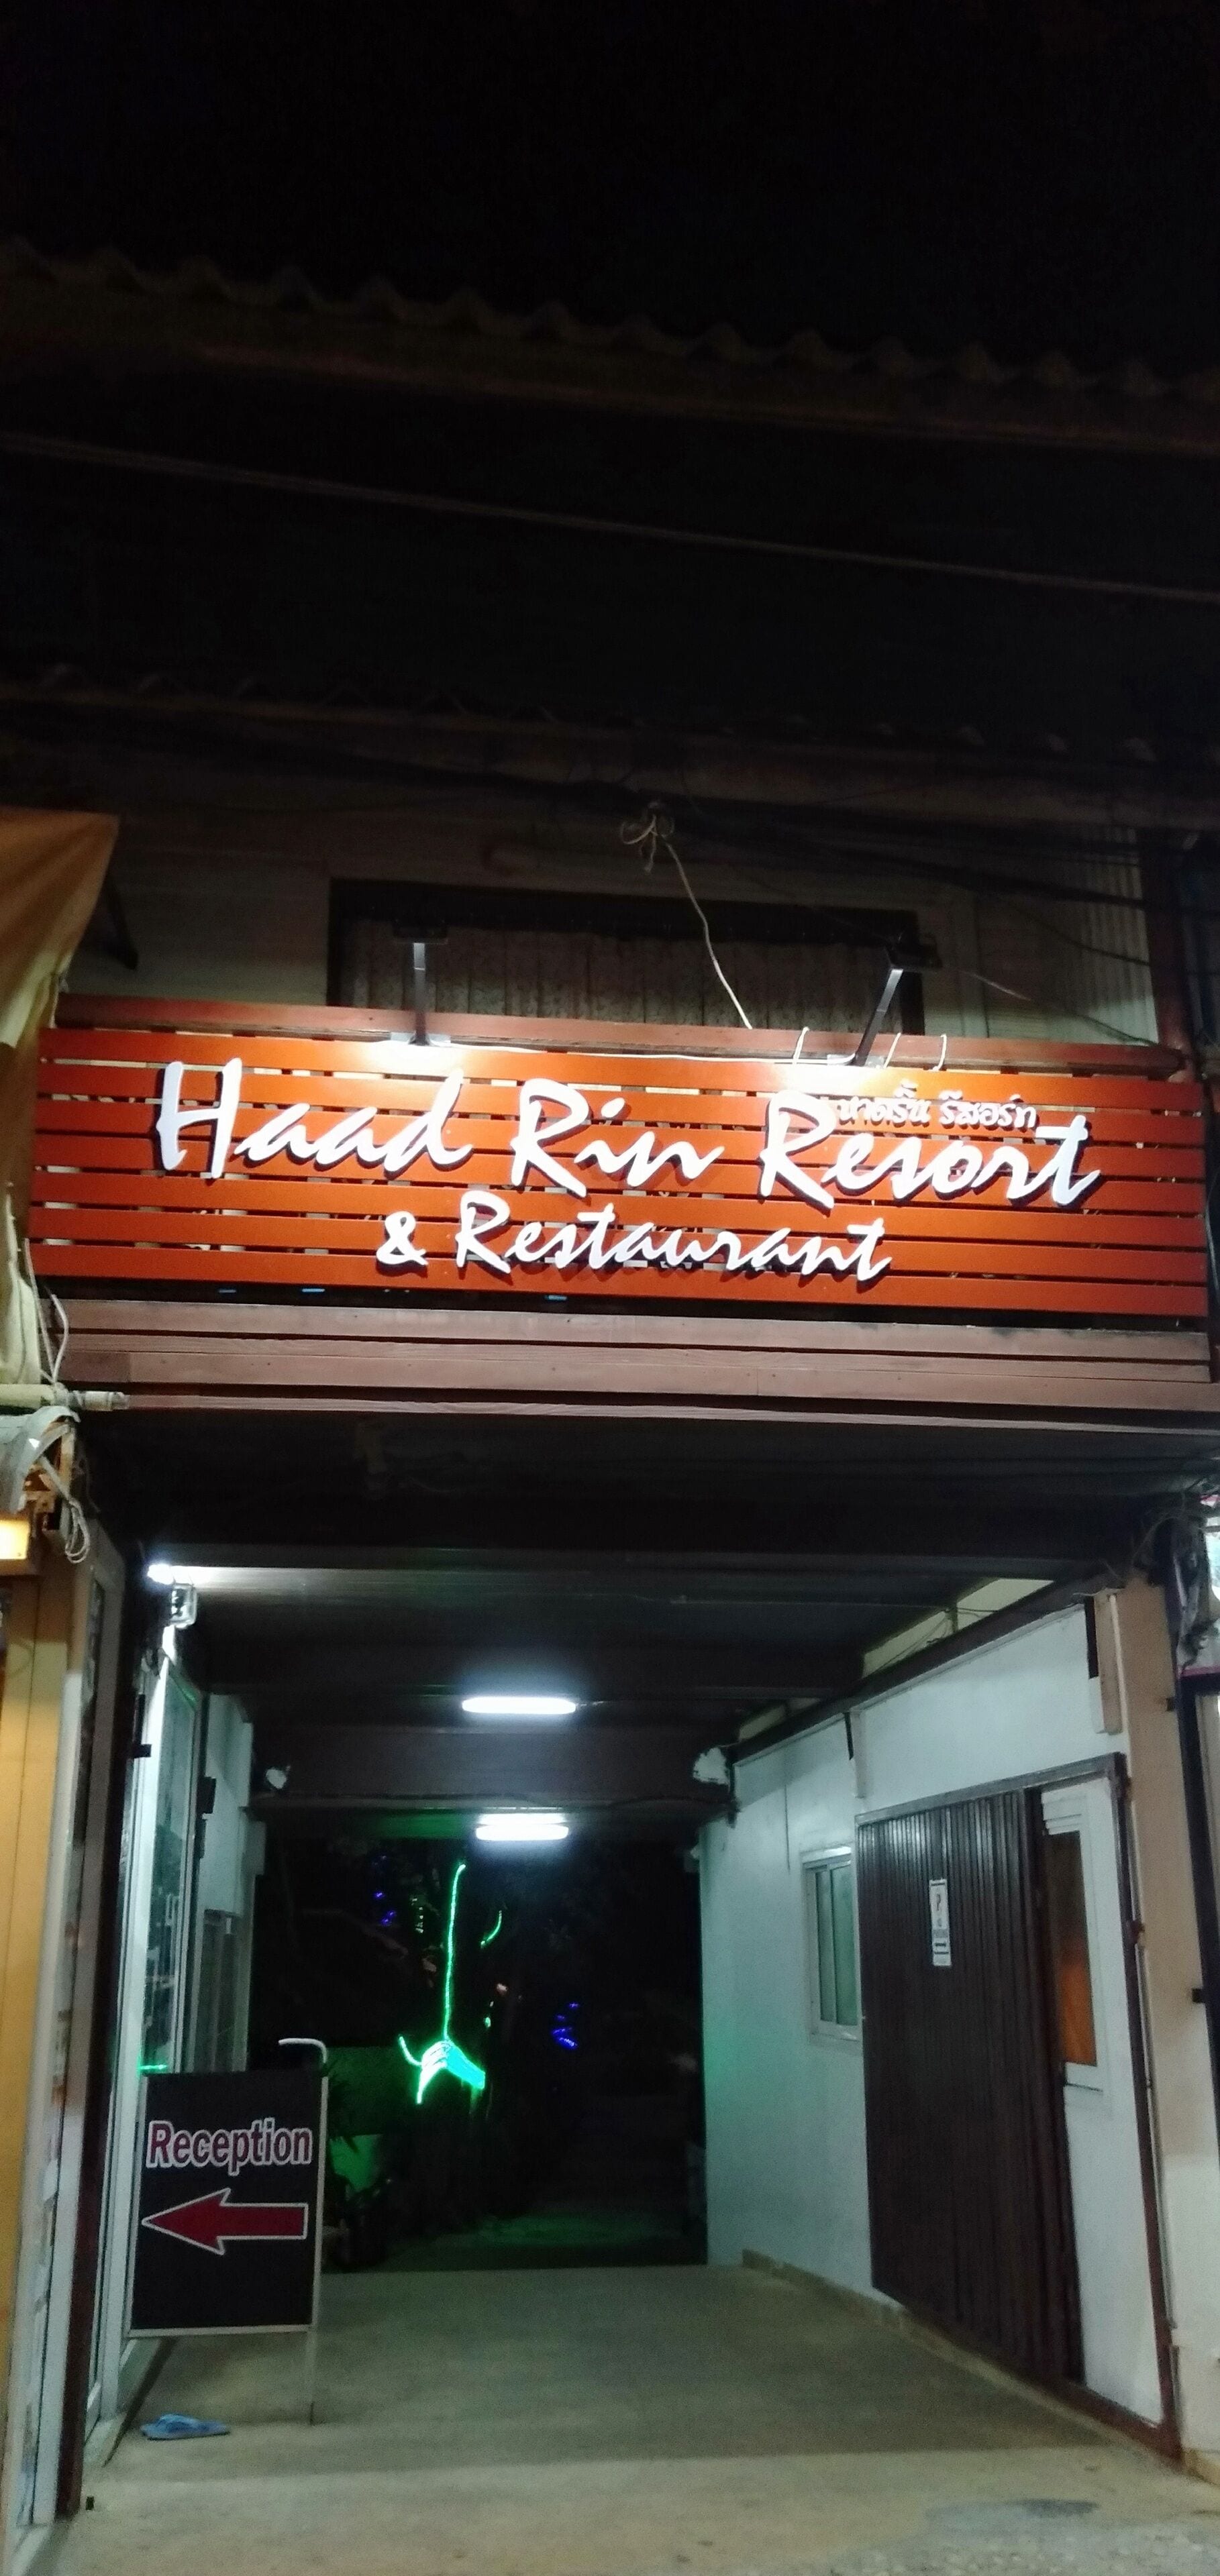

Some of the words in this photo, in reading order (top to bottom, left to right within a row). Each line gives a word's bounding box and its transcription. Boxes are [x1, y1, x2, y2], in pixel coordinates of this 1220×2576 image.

[155, 1057, 472, 1179] Haad
[511, 1078, 725, 1197] Rin
[760, 1089, 1102, 1209] Resort
[939, 1090, 1036, 1128] รีสอร์ท
[376, 1210, 428, 1266] &
[454, 1190, 893, 1281] Restaurant
[146, 2117, 313, 2176] Reception
